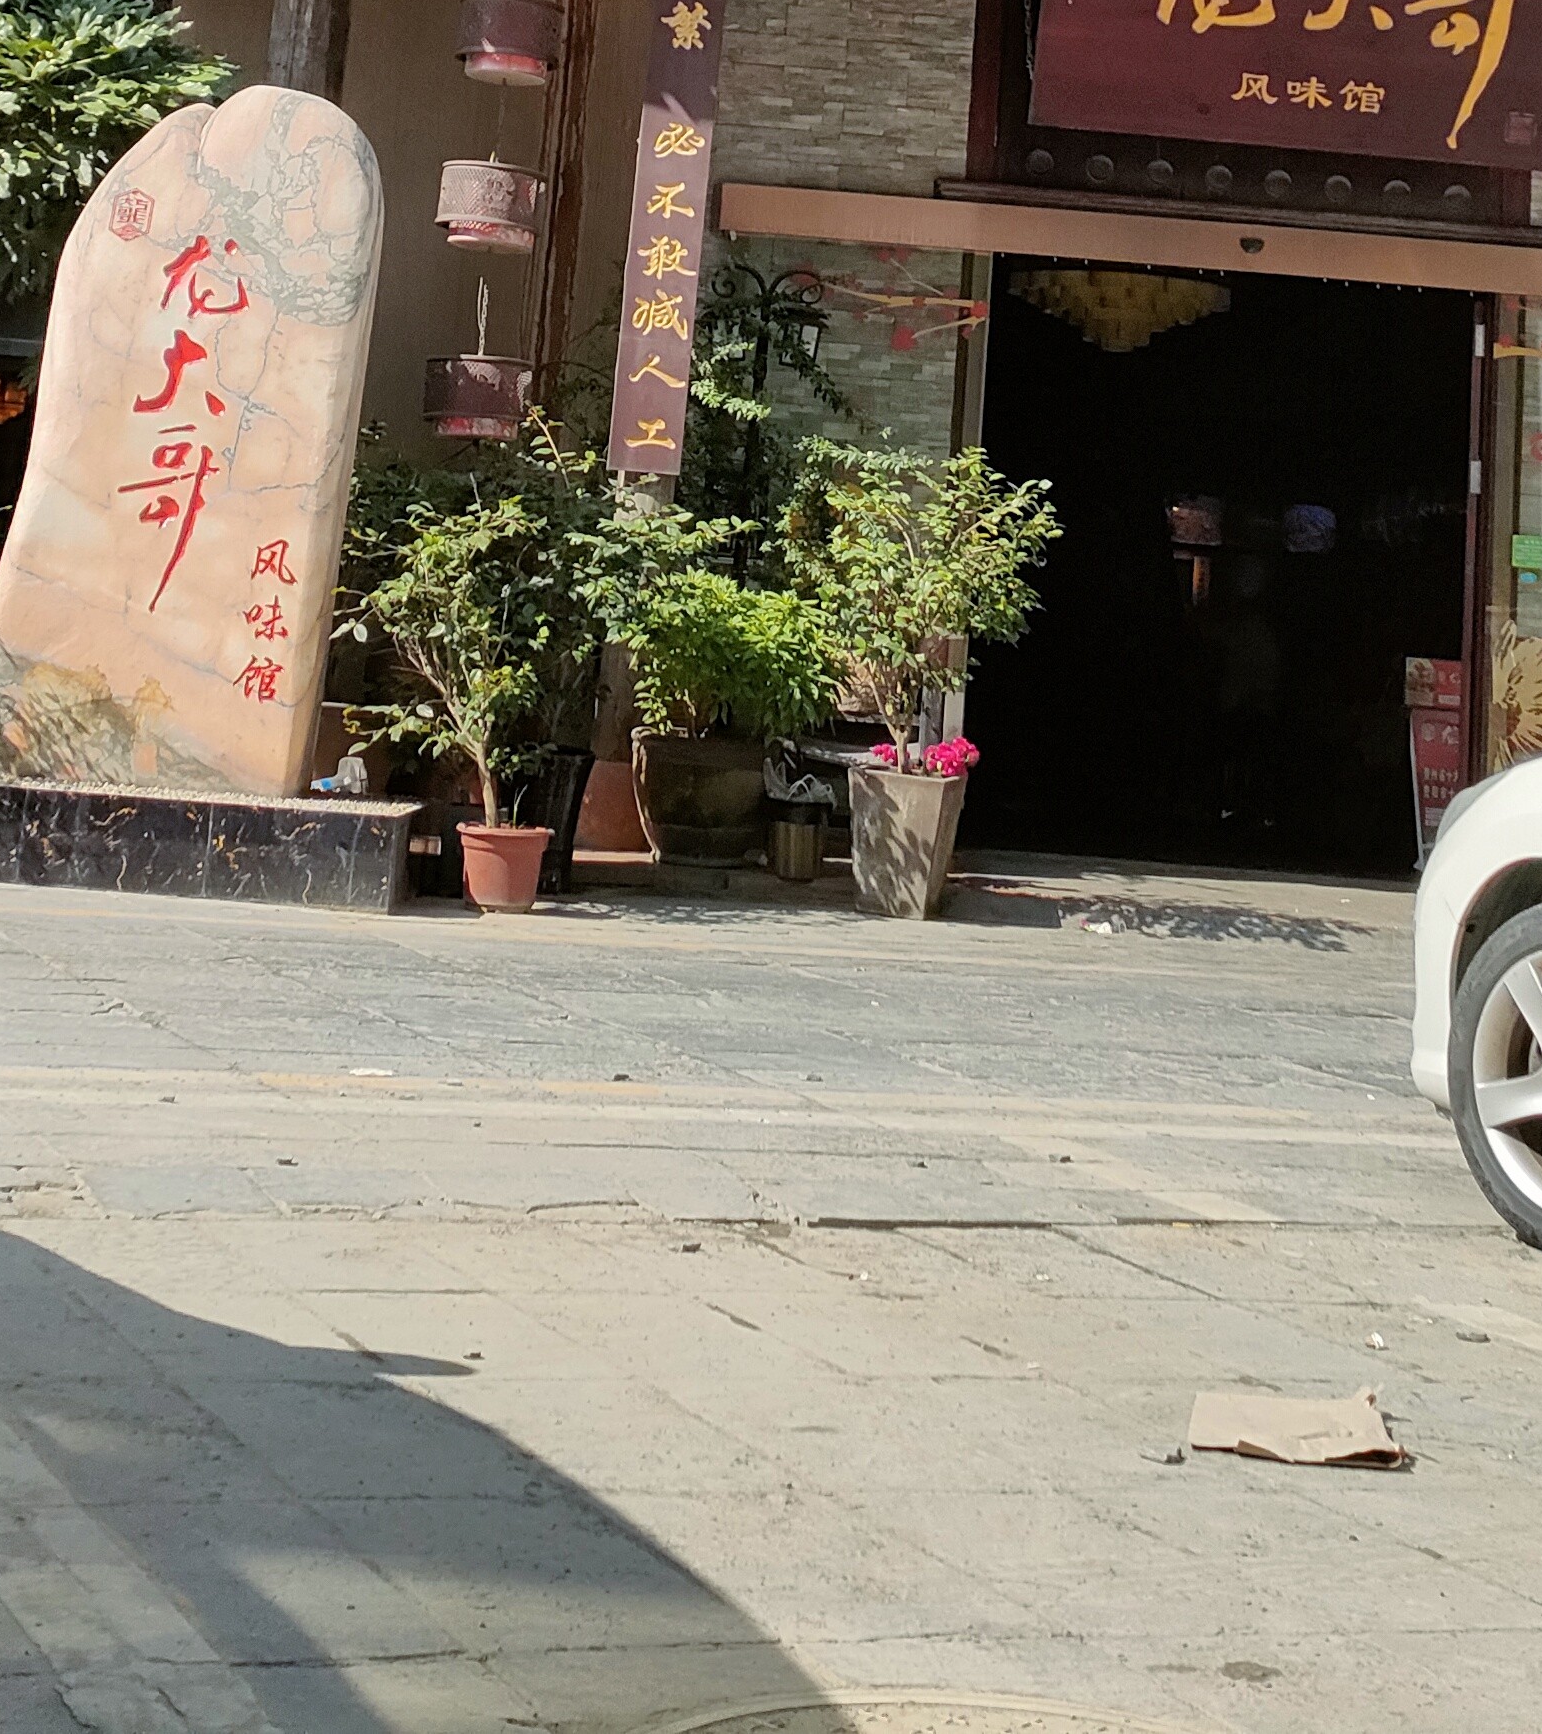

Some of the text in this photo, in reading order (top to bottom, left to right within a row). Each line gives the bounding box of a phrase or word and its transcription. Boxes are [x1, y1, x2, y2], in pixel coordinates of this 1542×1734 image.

[1230, 71, 1386, 115] 风味馆
[117, 233, 250, 614] 龙大哥
[231, 539, 298, 706] 风味馆
